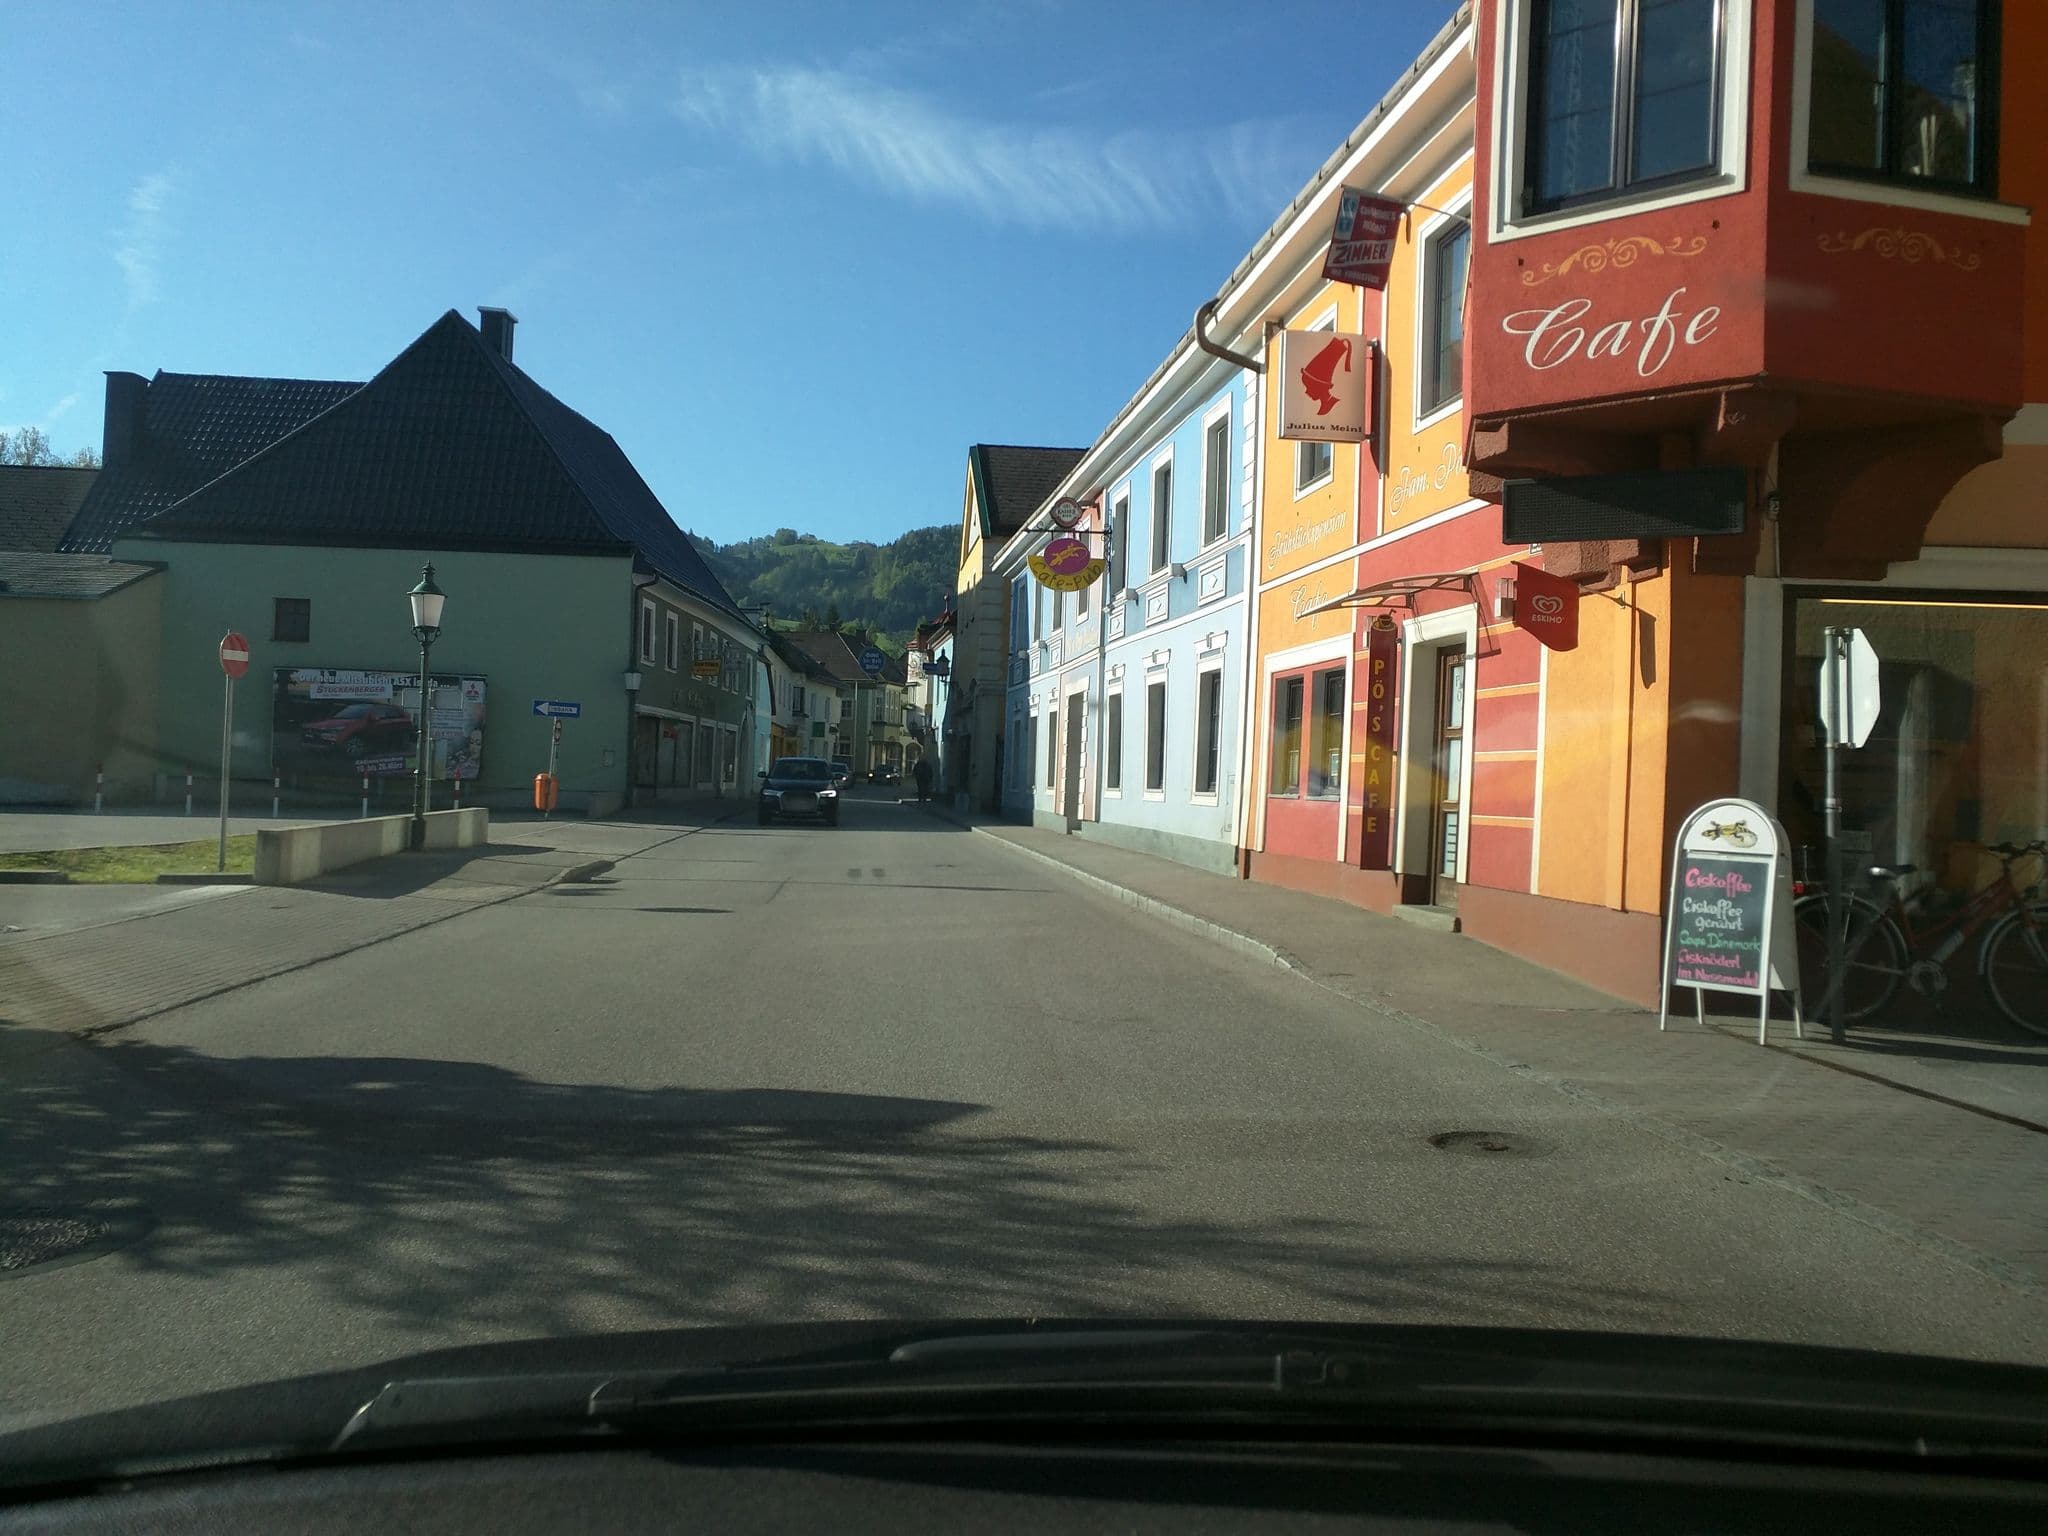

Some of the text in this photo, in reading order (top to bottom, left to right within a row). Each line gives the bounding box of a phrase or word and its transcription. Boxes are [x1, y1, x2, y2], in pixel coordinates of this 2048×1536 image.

[1333, 242, 1388, 264] ZIMMER
[1502, 286, 1722, 377] Cafe
[1286, 422, 1363, 433] Julius Meinl
[1531, 614, 1563, 624] ESKIMO
[393, 676, 412, 687] ASX
[1367, 745, 1381, 833] CAFE
